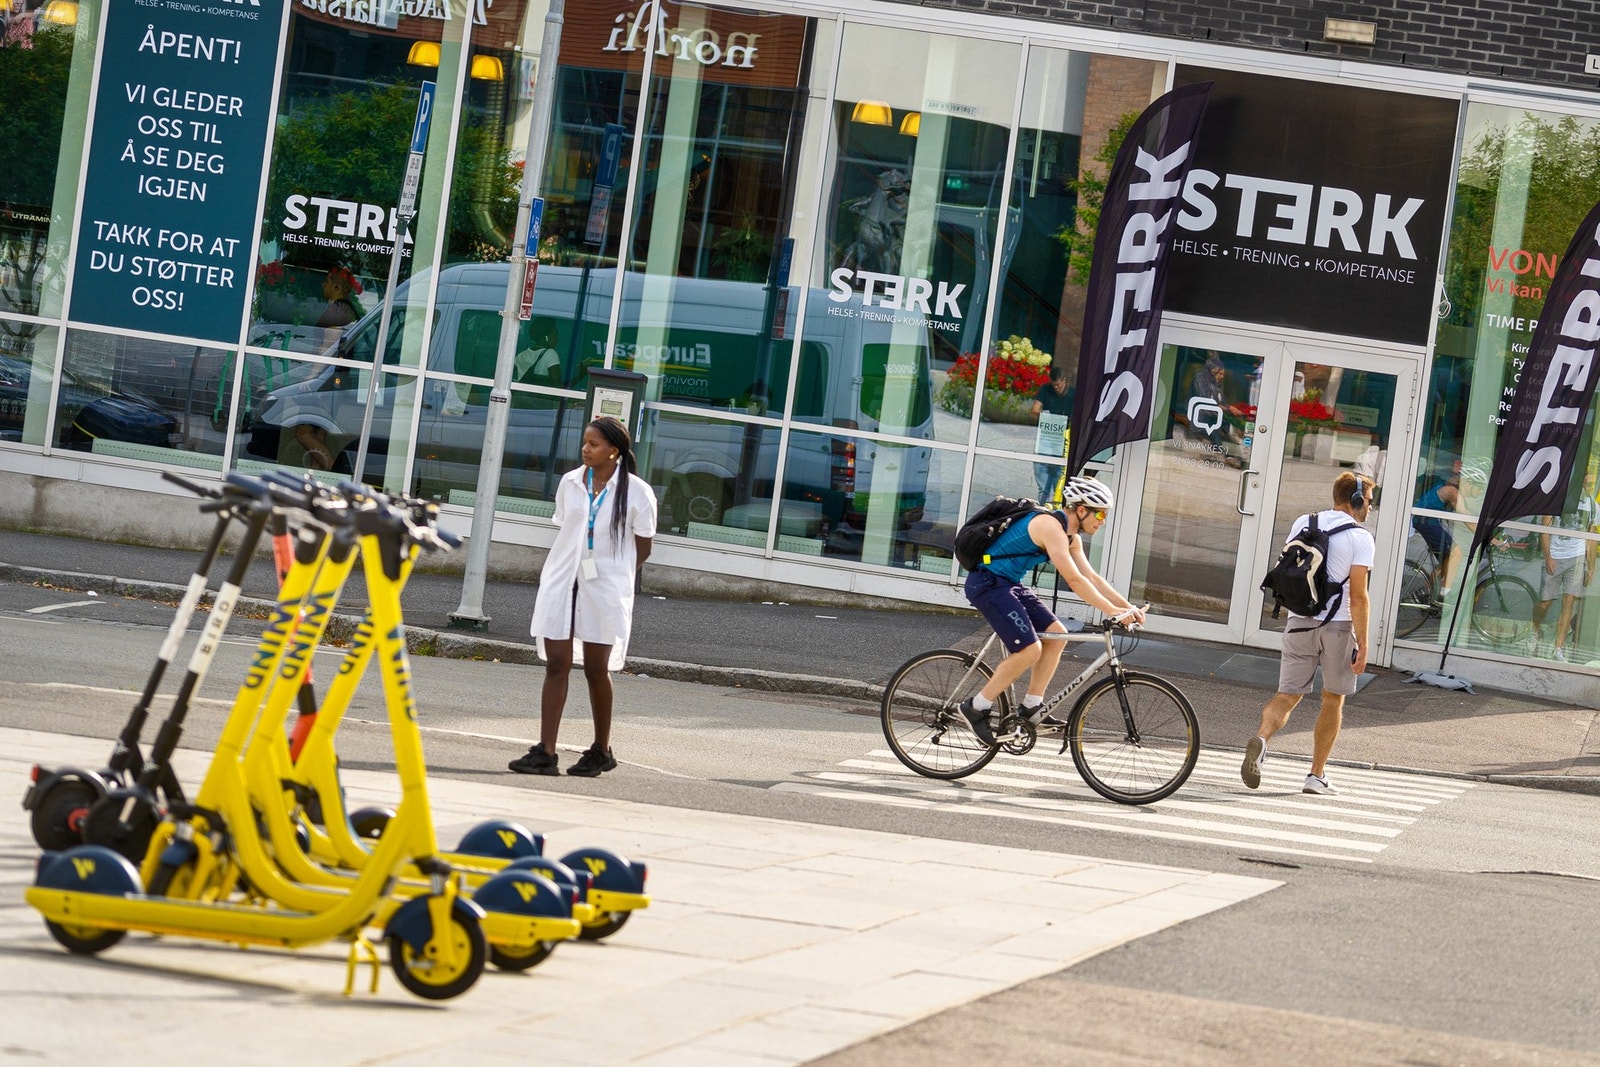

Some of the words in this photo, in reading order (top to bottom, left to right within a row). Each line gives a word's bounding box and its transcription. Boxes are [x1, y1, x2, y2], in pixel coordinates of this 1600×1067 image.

[166, 1, 200, 13] TRENING
[207, 7, 260, 20] KOMPETANSE
[138, 24, 241, 64] ÅPENT!
[125, 82, 146, 104] VI
[153, 87, 243, 117] GLEDER
[415, 92, 430, 143] P
[138, 115, 183, 139] OSS
[189, 121, 223, 144] TIL
[120, 138, 136, 163] Å
[143, 145, 169, 167] SE
[176, 149, 224, 174] DEG
[138, 174, 207, 202] IGJEN
[1176, 168, 1425, 260] STERK
[94, 220, 152, 247] TAKK
[157, 229, 204, 254] FOR
[209, 237, 240, 258] AT
[282, 232, 309, 244] HELSE
[313, 236, 350, 250] TRENING
[355, 242, 412, 258] KOMPETASE
[90, 250, 124, 272] DU
[130, 255, 234, 288] STØTTER
[1173, 239, 1218, 257] HELSE
[1233, 246, 1300, 268] TRENING
[1314, 258, 1416, 284] KOMPETANSE
[1488, 246, 1562, 280] VON
[132, 286, 184, 311] OSS!
[827, 267, 967, 319] STERK
[1487, 277, 1504, 294] Vi
[1509, 284, 1542, 299] kan
[827, 306, 854, 318] HELSE
[860, 310, 897, 324] TRENING
[902, 315, 961, 332] KOMPETANSE
[1486, 313, 1525, 331] TIME
[1040, 421, 1064, 433] FRISK
[200, 600, 230, 657] BIRD
[245, 597, 304, 689] WIND
[280, 591, 336, 680] WIND
[1039, 676, 1084, 718] NISHIKI
